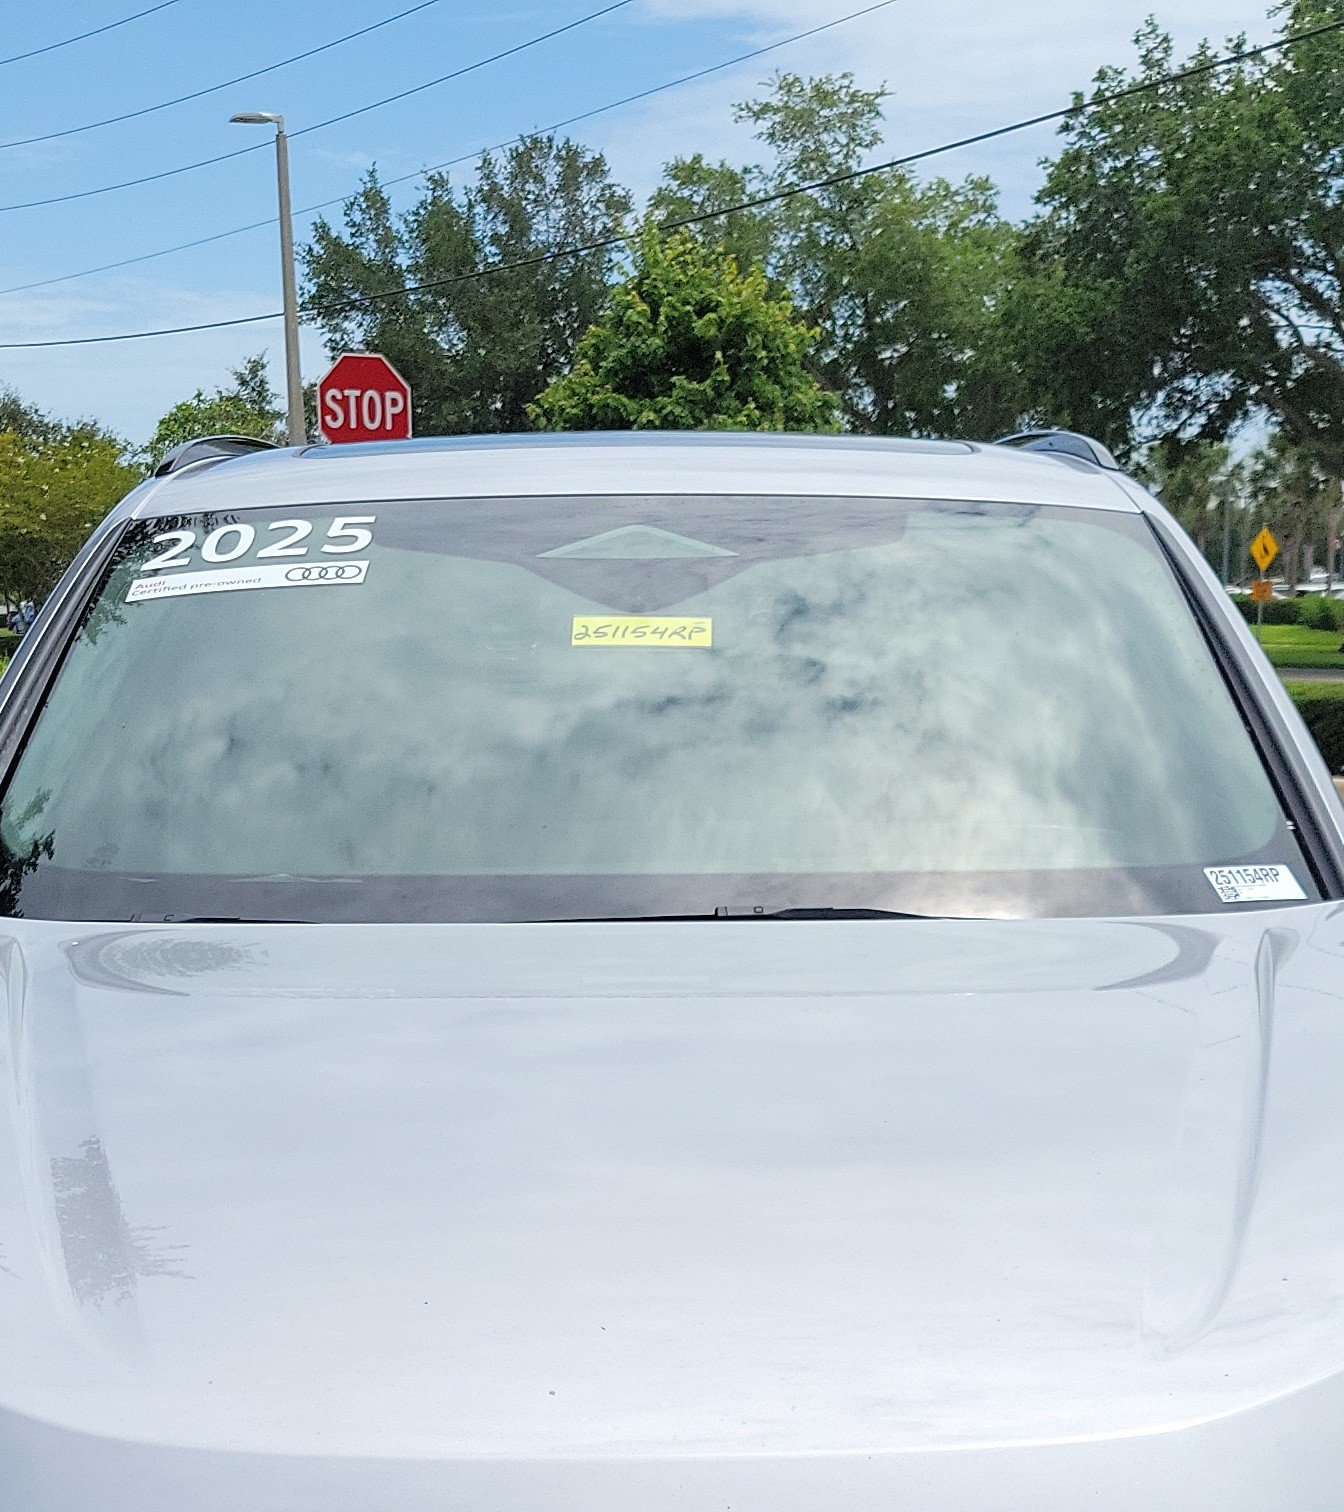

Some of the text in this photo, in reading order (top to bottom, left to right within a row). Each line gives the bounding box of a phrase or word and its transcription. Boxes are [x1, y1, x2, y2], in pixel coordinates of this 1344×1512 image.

[324, 388, 405, 431] STOP
[139, 515, 377, 571] 2025
[130, 577, 263, 597] Certified pre-owned
[133, 579, 167, 590] Audi
[573, 623, 707, 641] 251154RP
[1209, 867, 1281, 886] 251154RP
